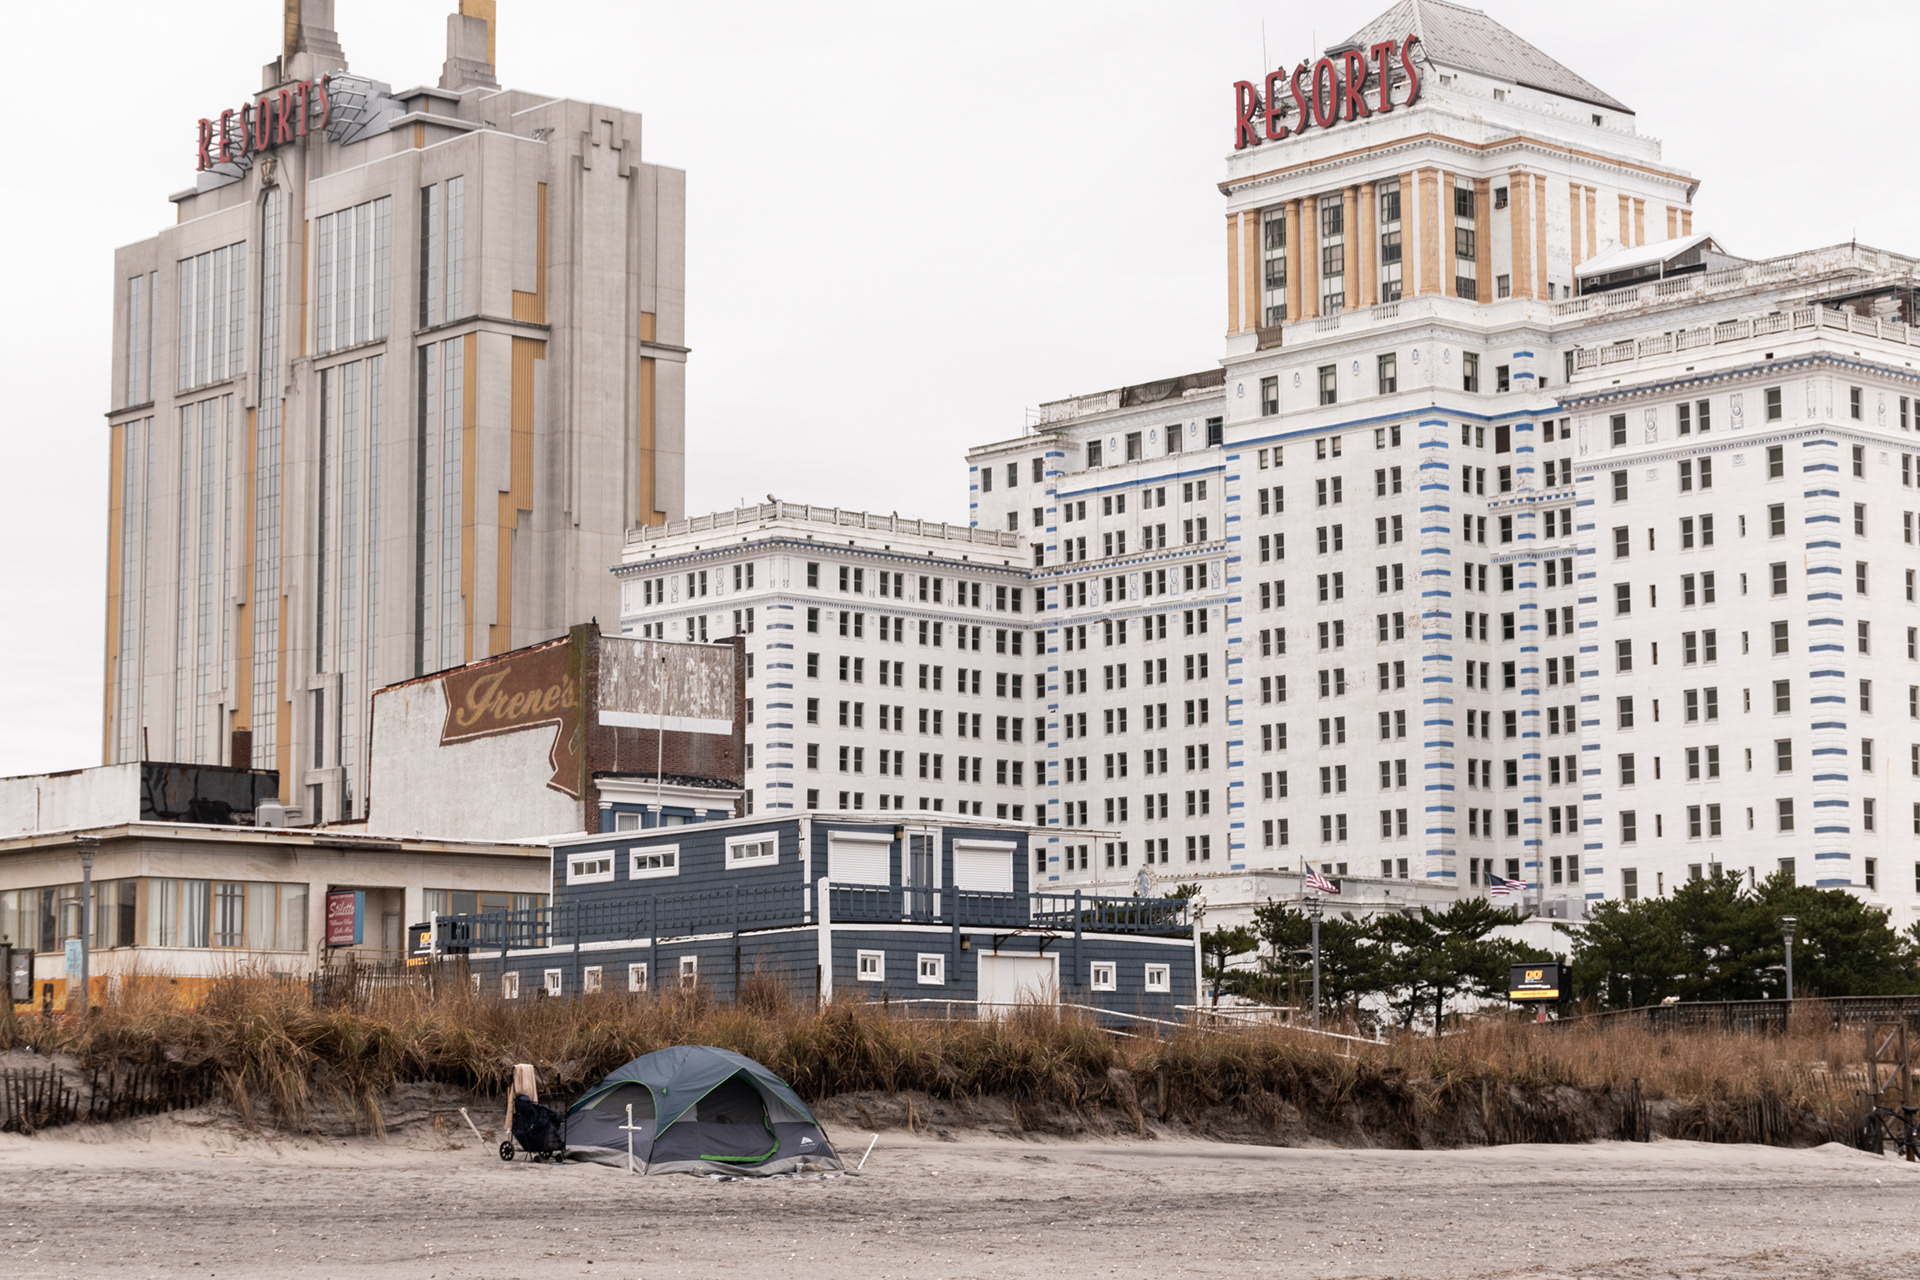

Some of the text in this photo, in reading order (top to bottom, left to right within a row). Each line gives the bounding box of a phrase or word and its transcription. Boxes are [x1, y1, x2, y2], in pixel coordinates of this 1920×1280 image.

[196, 72, 332, 171] RESORTS
[1233, 33, 1421, 149] RESORTS
[456, 665, 579, 725] Irene's
[328, 901, 355, 918] Stiletto
